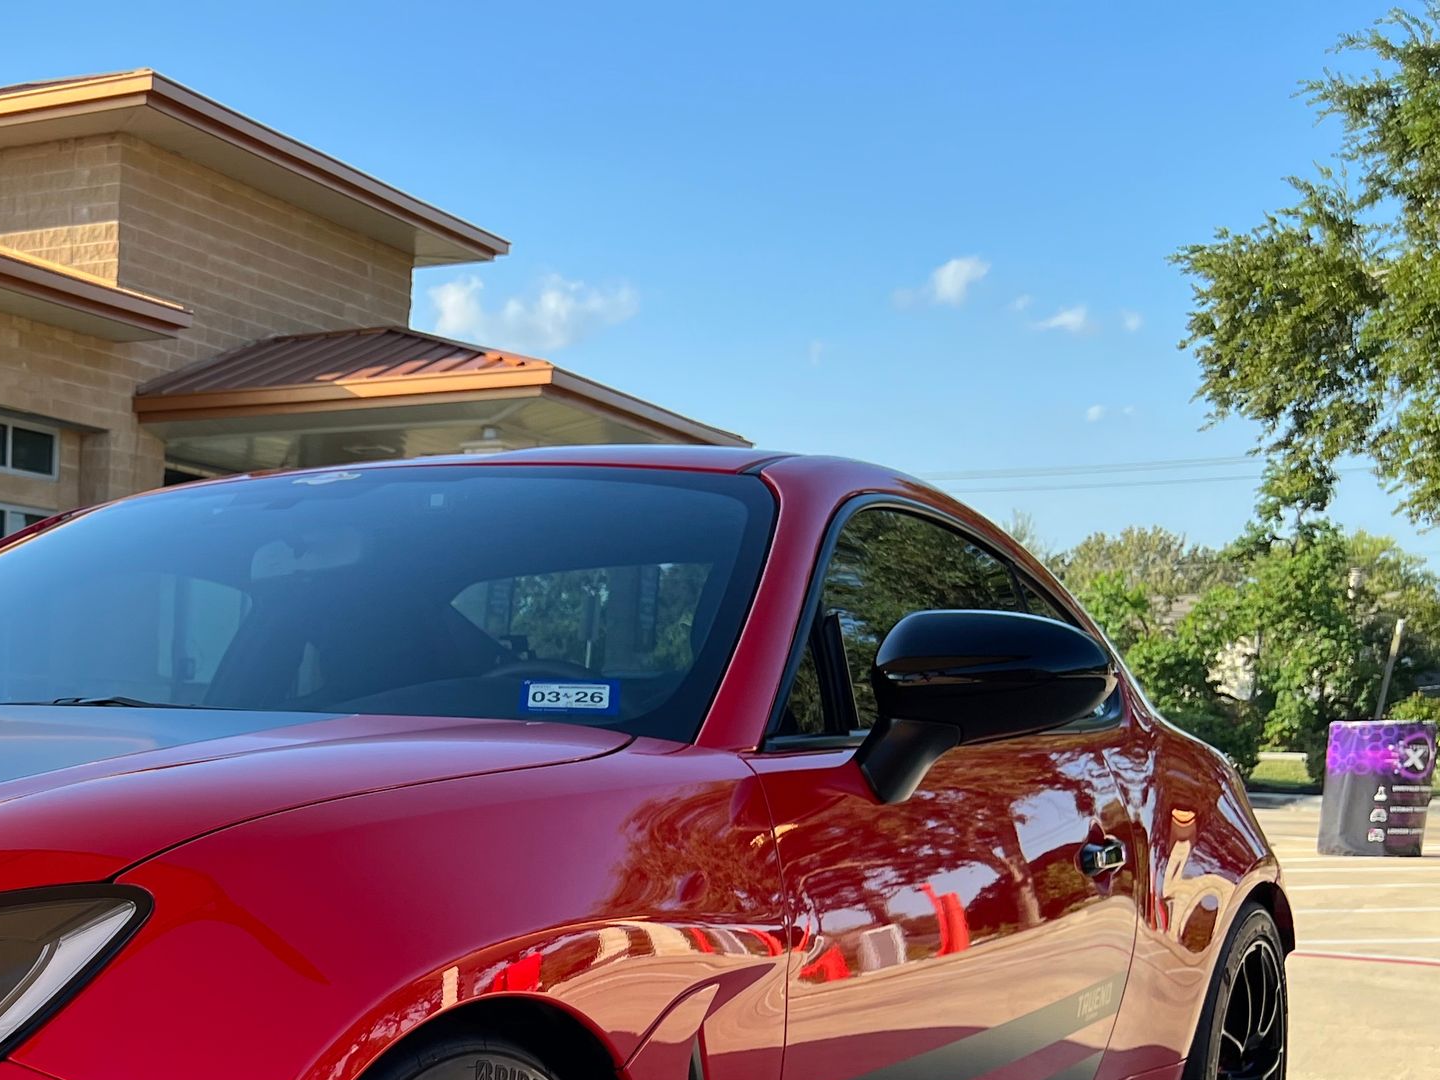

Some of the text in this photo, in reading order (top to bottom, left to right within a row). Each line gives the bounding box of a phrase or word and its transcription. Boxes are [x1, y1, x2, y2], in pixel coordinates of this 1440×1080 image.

[531, 691, 604, 703] 03 26
[1076, 982, 1113, 1018] TRUENO
